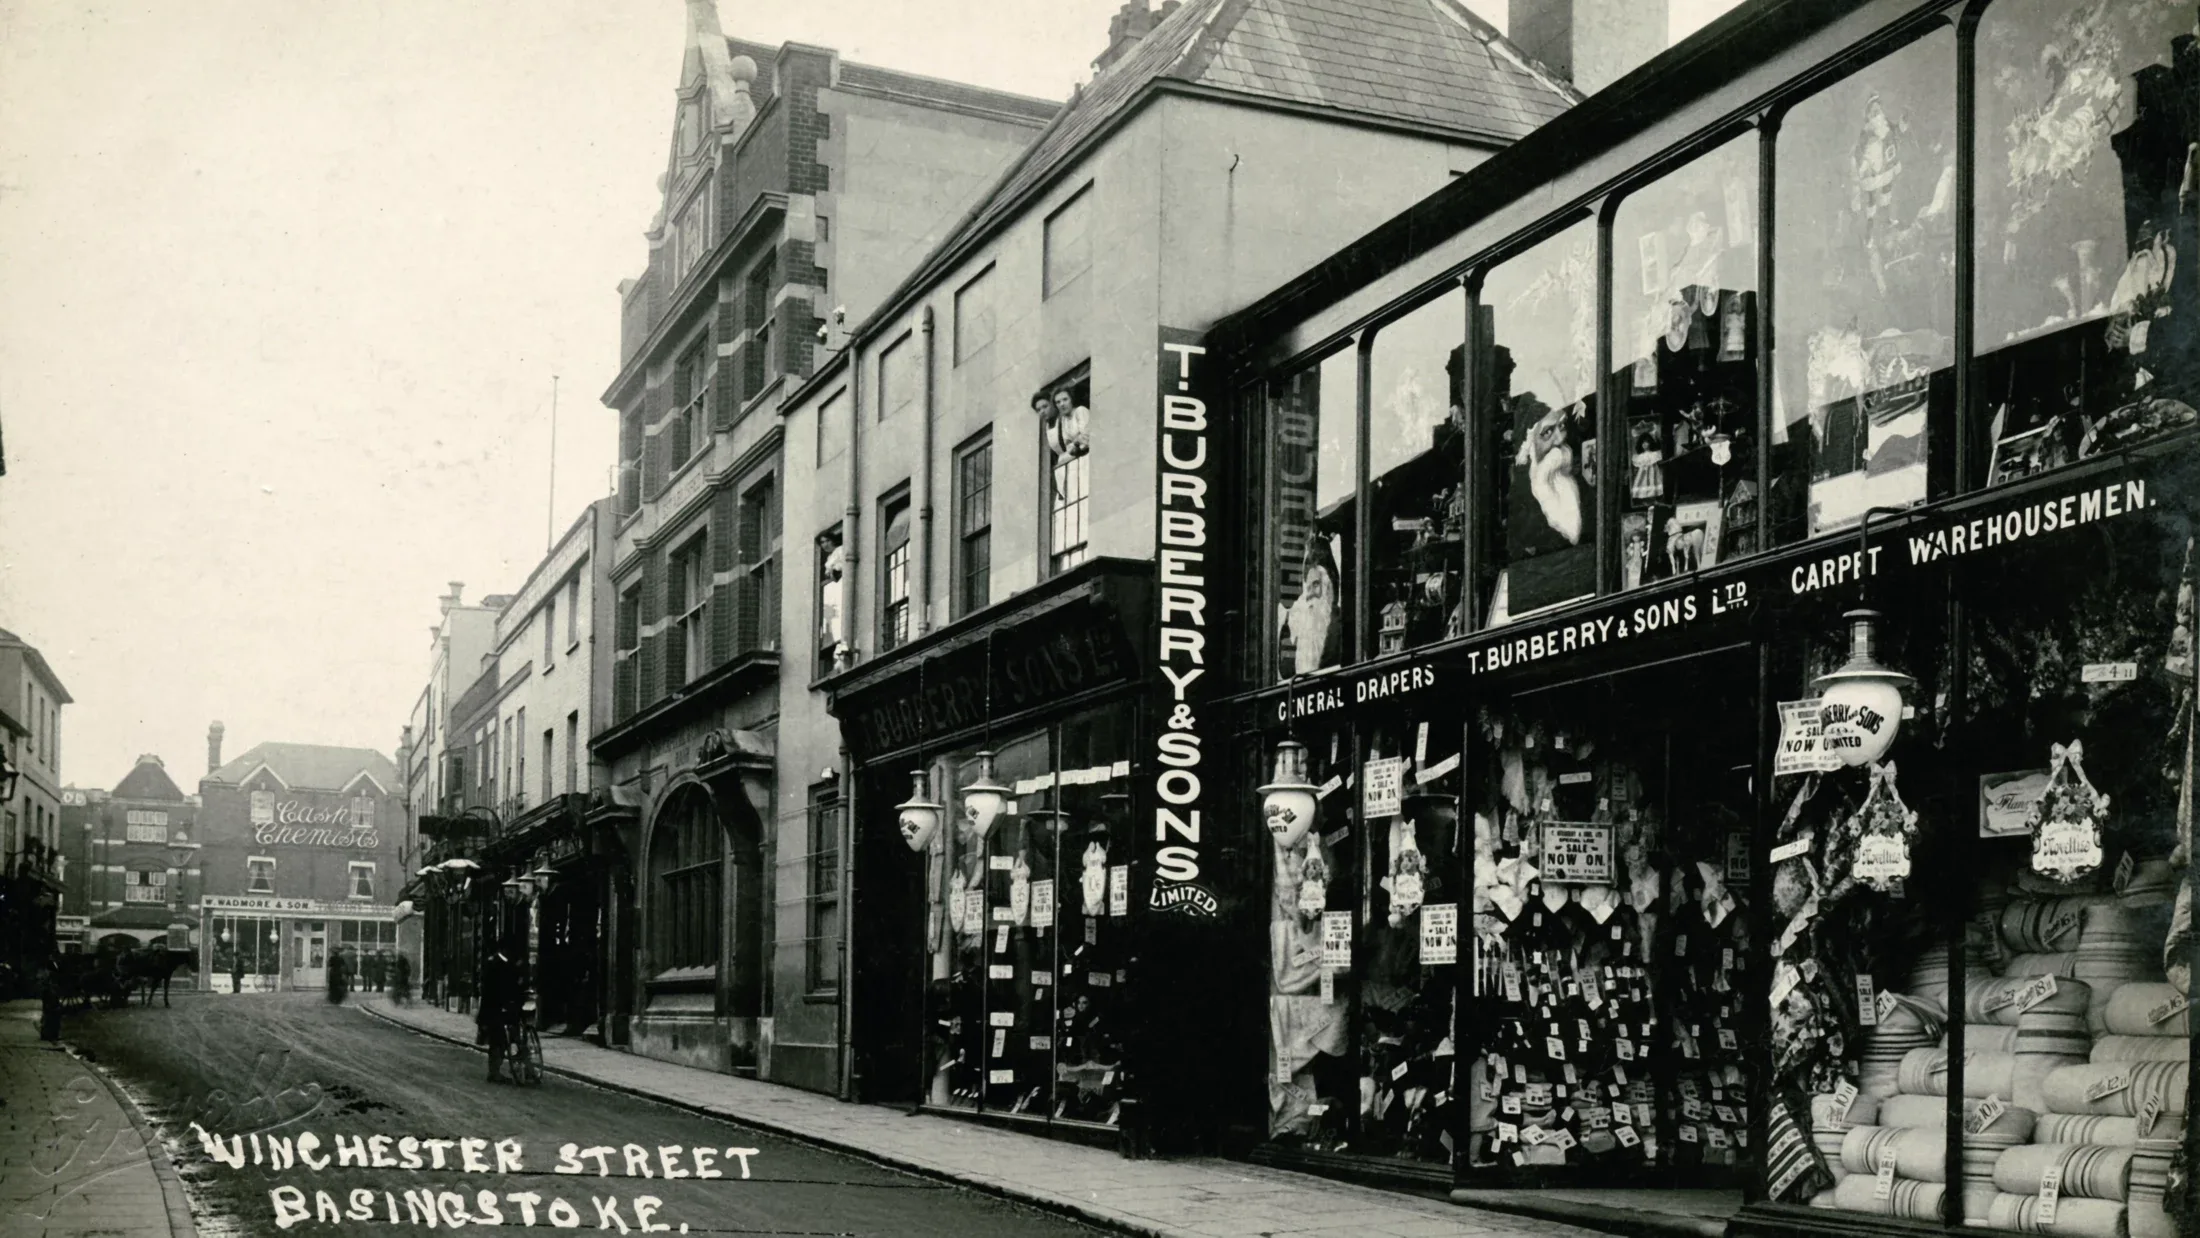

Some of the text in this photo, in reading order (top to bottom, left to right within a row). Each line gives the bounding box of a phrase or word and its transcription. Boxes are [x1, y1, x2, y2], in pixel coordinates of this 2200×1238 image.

[1909, 479, 2157, 566] WAREHOUSEMEN.
[1617, 620, 1629, 638] &
[1634, 595, 1697, 633] SONS
[1278, 664, 1434, 721] GNERAL DRAPERS
[1168, 703, 1196, 730] &
[1856, 706, 1884, 735] SONS
[1785, 739, 1815, 753] NOW
[277, 800, 351, 826] Cash
[1156, 733, 1202, 881] SONS
[255, 822, 379, 849] Chemists
[1547, 853, 1577, 865] NOW
[1566, 844, 1587, 853] SALE
[218, 899, 270, 909] WADMORE
[1326, 941, 1340, 951] NOW
[1425, 936, 1442, 947] NOW
[2108, 1076, 2118, 1091] 12
[1979, 1101, 1992, 1120] 10
